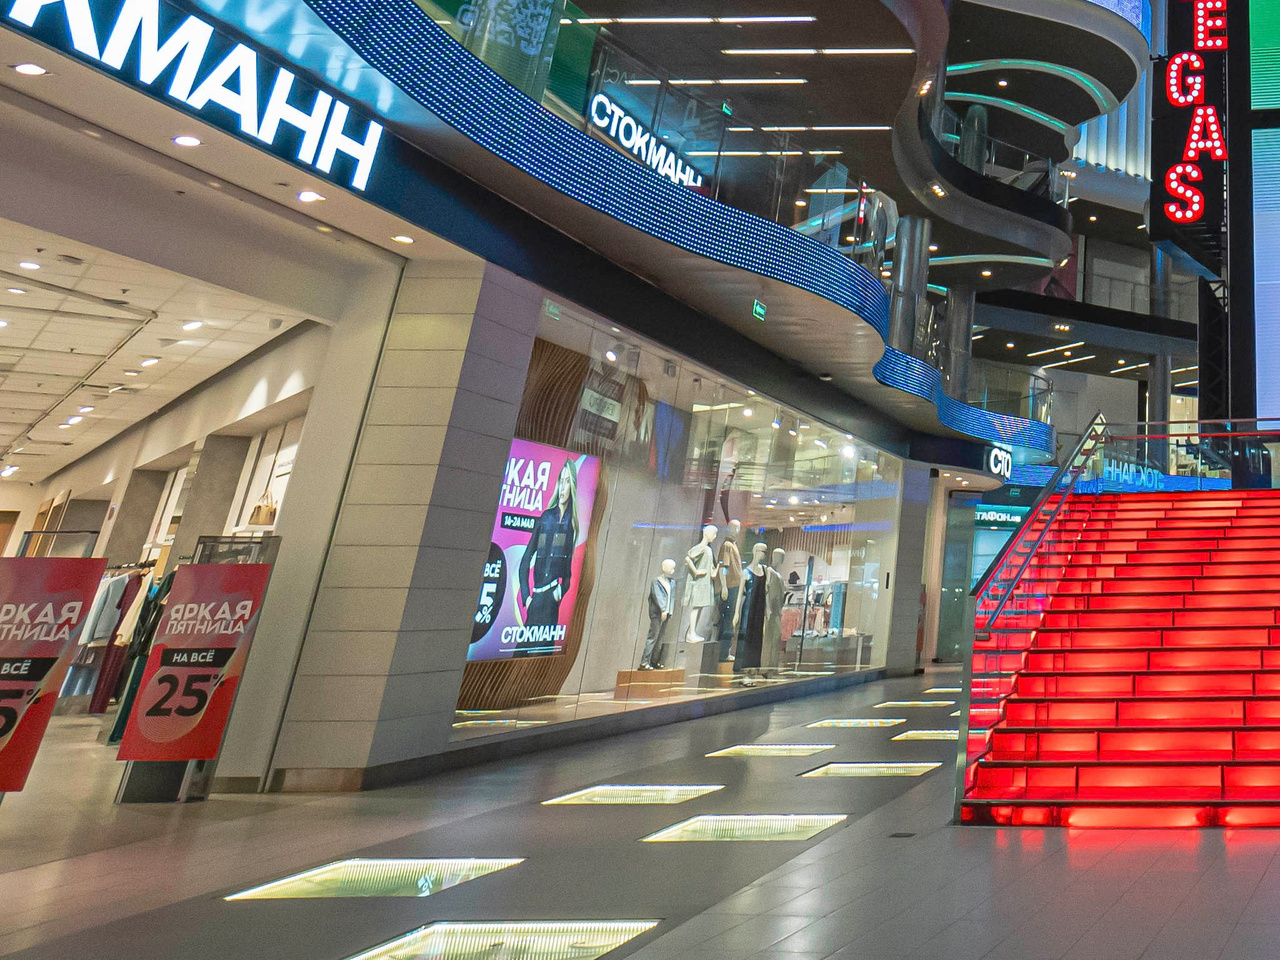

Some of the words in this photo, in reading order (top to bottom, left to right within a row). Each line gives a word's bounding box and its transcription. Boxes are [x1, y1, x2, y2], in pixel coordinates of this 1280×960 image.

[591, 93, 703, 187] СТОКМАНН
[505, 457, 551, 492] КАЯ
[520, 517, 535, 529] МАЯ
[484, 560, 501, 577] ВСЁ
[170, 600, 253, 622] ЯРКАЯ
[165, 619, 245, 635] ПЯТНИЦА
[501, 625, 566, 644] СТОКМАНН
[173, 652, 188, 663] НА
[190, 649, 216, 663] ВСЁ
[1, 659, 32, 675] ВСЁ
